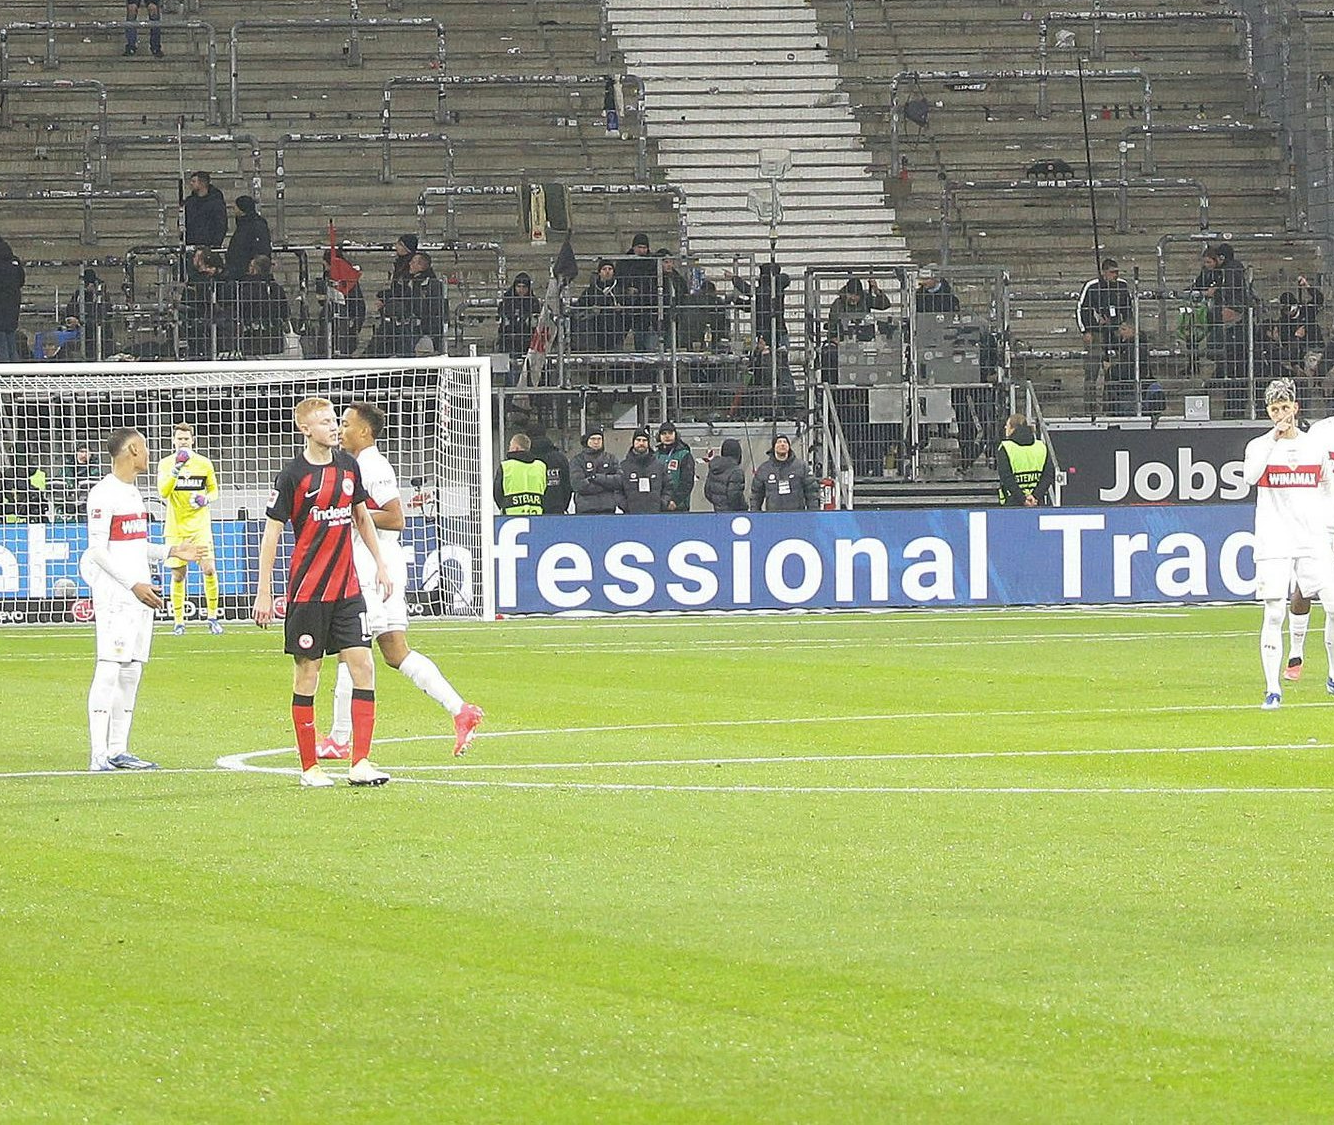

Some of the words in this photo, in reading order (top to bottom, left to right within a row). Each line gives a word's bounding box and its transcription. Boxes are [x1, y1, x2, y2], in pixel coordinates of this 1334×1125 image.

[1099, 447, 1256, 502] Jobs
[1268, 472, 1317, 486] WINAMAX
[310, 502, 352, 522] indeed
